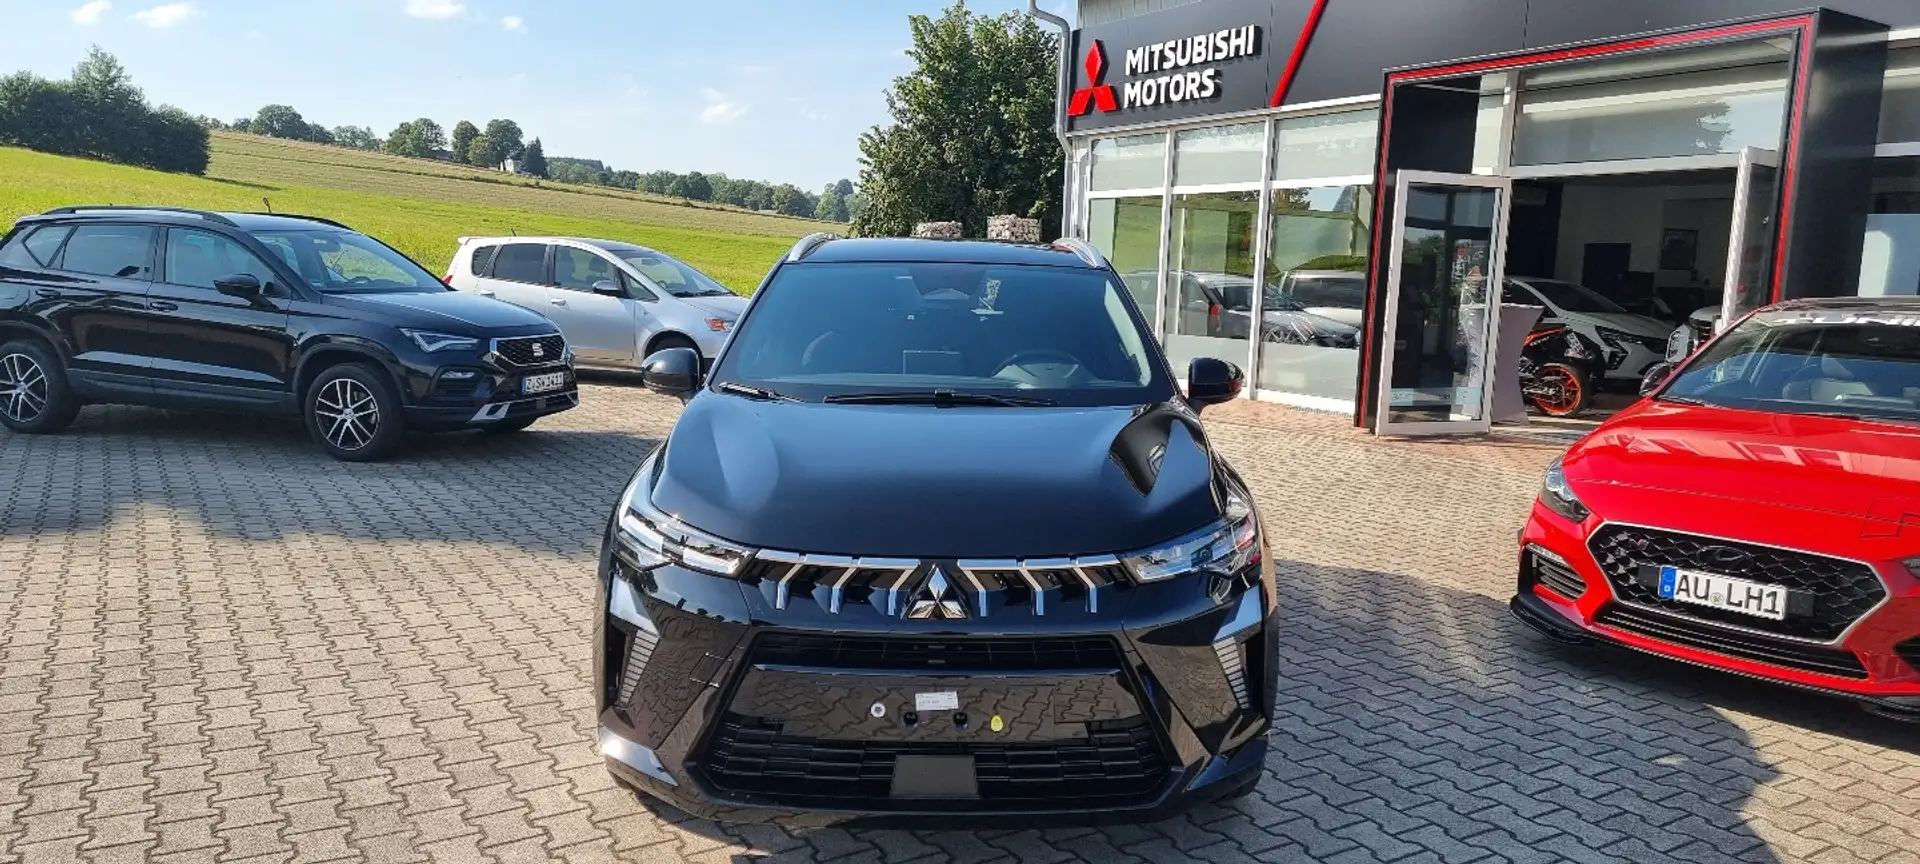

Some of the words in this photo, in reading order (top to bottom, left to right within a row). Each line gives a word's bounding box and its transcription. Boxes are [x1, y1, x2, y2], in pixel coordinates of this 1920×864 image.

[1125, 24, 1255, 76] MITSUBISHI
[1123, 68, 1215, 108] MOTORS
[1676, 574, 1711, 602] AU
[1725, 582, 1781, 615] LH1
